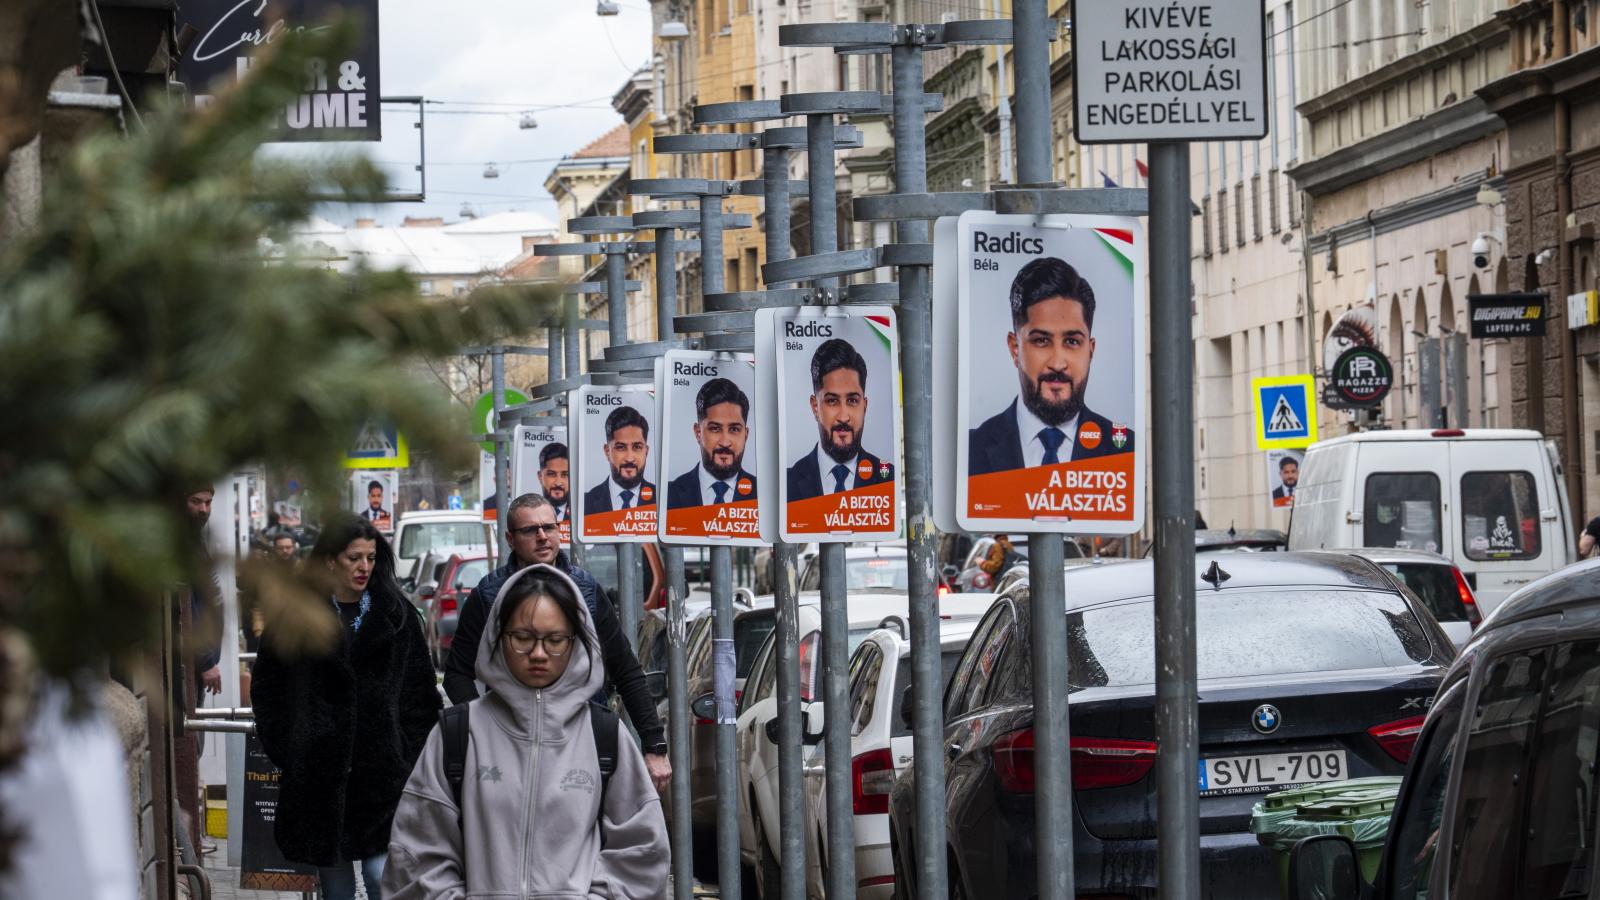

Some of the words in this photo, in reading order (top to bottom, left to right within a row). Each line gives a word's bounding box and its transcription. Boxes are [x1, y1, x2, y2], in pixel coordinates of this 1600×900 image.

[1125, 1, 1212, 29] KIVÉVE
[1101, 33, 1236, 62] LAKOSSÁGI
[338, 60, 366, 91] &
[1105, 64, 1241, 93] PARKOLÁSI
[1087, 97, 1255, 126] ENGEDÉLLYEL
[973, 231, 1044, 254] Radics
[973, 258, 999, 271] Béla
[785, 320, 833, 338] Radics
[1486, 323, 1516, 333] LAPTOP
[785, 342, 803, 351] Béla
[674, 361, 718, 376] Radics
[673, 378, 690, 386] Béla
[1338, 377, 1388, 387] RAGAZZE
[586, 394, 623, 406] Radics
[524, 432, 555, 441] Radics
[1079, 431, 1102, 439] FIDESZ
[1049, 470, 1062, 488] A
[1066, 471, 1127, 489] BIZTOS
[839, 496, 849, 509] A
[850, 495, 890, 509] BIZTOS
[1025, 488, 1126, 512] VÁLASZTÁS
[625, 511, 632, 520] A
[634, 511, 657, 521] BIZT
[717, 507, 726, 518] A
[729, 507, 759, 520] BIZTO
[824, 509, 890, 526] VÁLASZTÁS
[702, 518, 759, 533] VÁLASZTÁ
[1213, 753, 1341, 786] SVL-709
